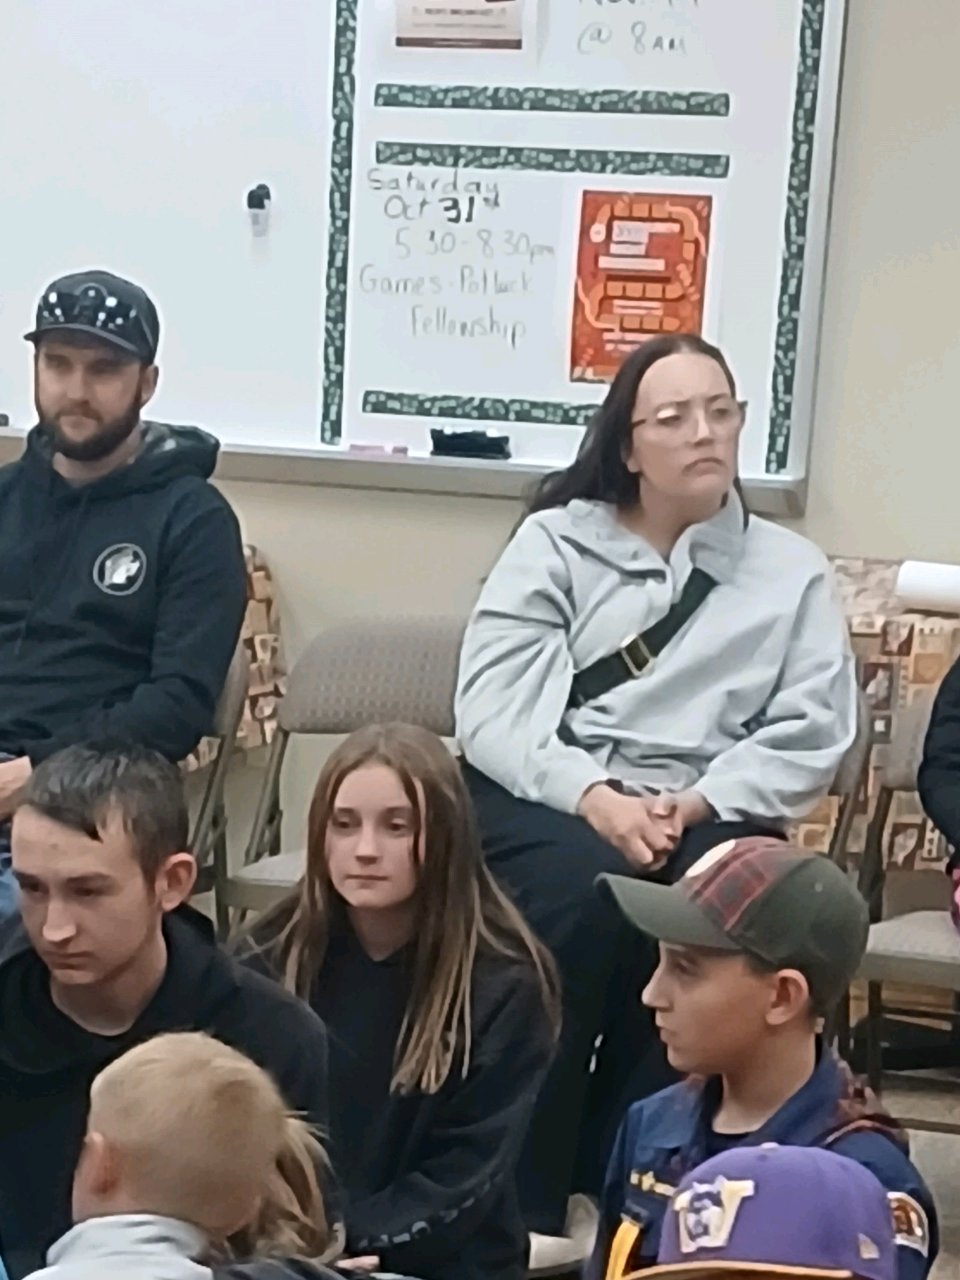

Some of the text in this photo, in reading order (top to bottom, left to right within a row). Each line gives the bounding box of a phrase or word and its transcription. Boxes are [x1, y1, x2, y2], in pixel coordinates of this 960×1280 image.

[368, 168, 499, 206] Saturday
[384, 194, 431, 221] Oct
[411, 304, 526, 350] Fellowship
